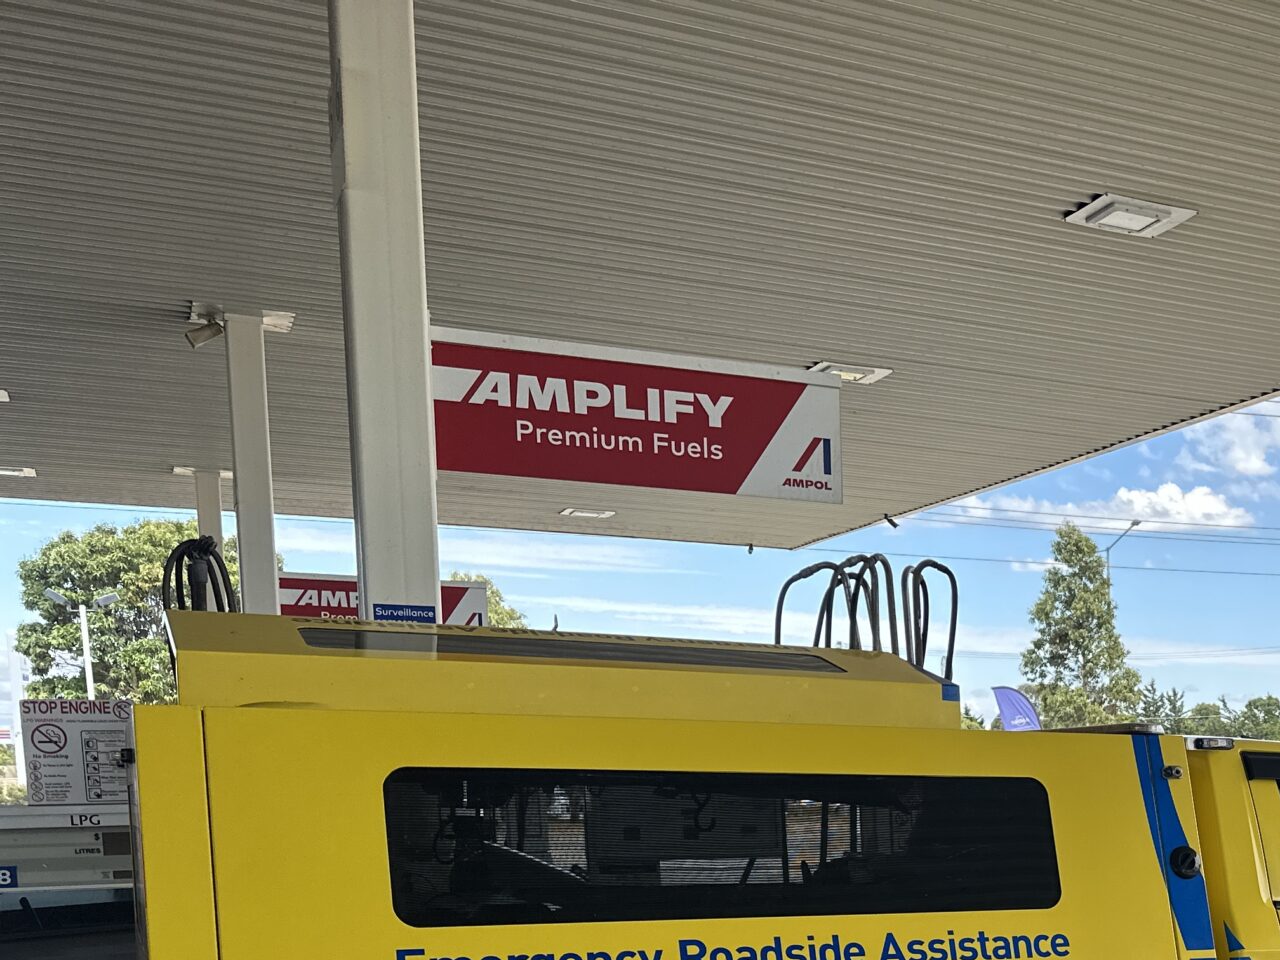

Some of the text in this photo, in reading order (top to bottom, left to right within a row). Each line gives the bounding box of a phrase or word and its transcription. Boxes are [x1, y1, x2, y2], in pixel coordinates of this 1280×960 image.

[468, 370, 735, 429] AMPLIFY
[515, 420, 724, 461] Premium Fuels
[781, 477, 833, 491] AMPOL
[375, 607, 434, 618] Surveillance
[22, 701, 112, 715] STOP ENGINE
[70, 814, 101, 826] LPG
[74, 847, 101, 855] LITRES
